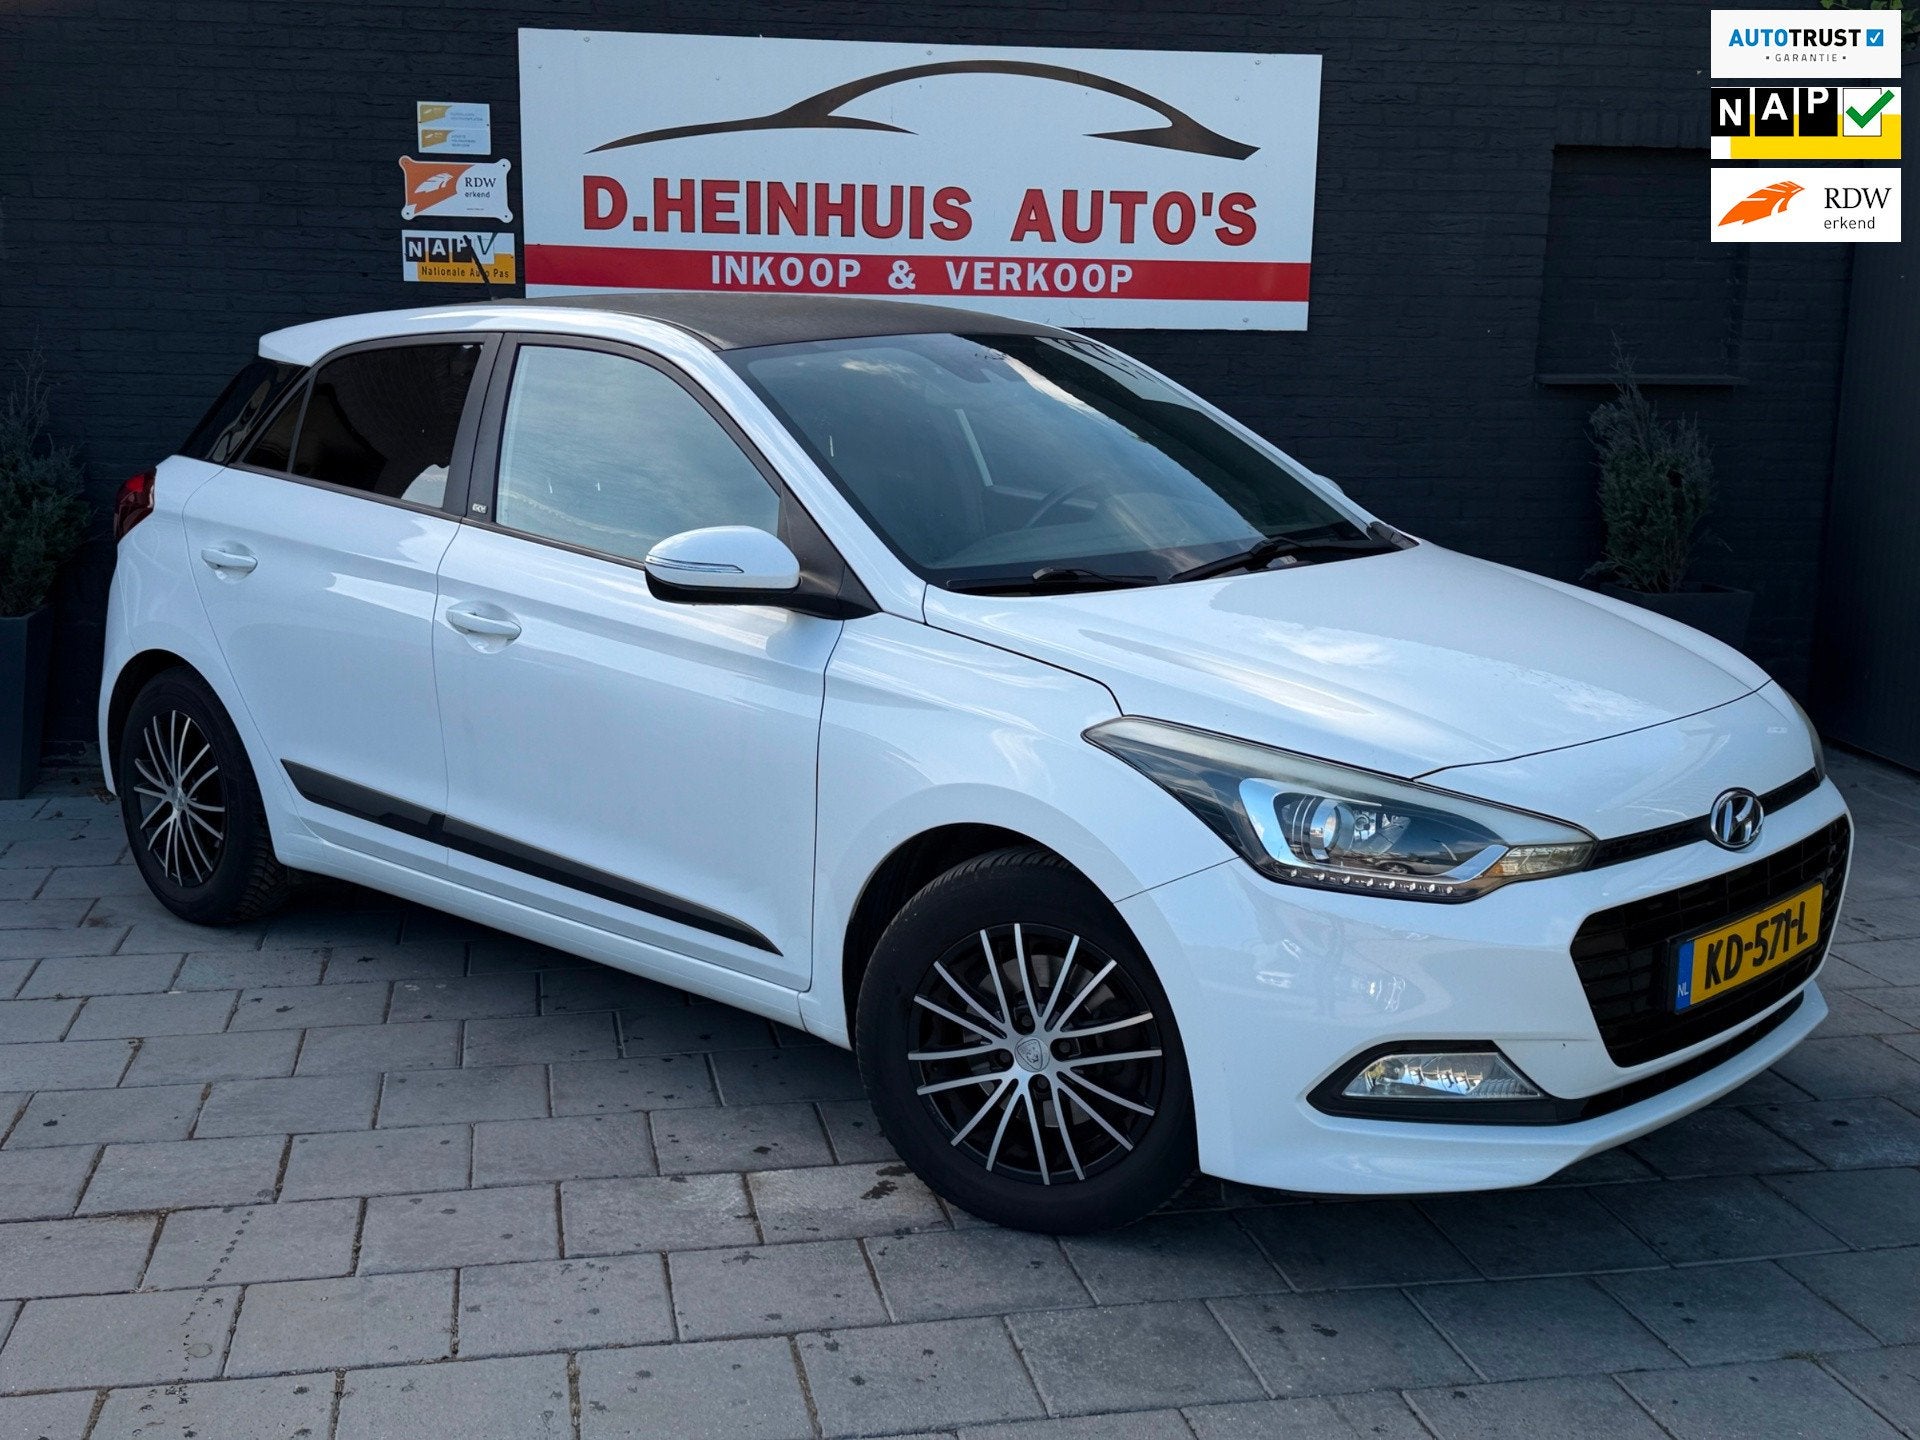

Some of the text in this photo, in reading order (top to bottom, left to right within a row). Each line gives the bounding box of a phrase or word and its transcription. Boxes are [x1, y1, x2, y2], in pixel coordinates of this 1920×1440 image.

[465, 177, 497, 188] RDW
[583, 174, 1258, 246] D.HEINHUIS AUTO'S
[408, 238, 468, 257] NAP
[421, 266, 509, 278] Nationale Auo Pas
[711, 254, 1134, 294] INKOOP & VERKOOP
[1705, 901, 1808, 990] KD-571-L
[1677, 984, 1689, 996] NL
